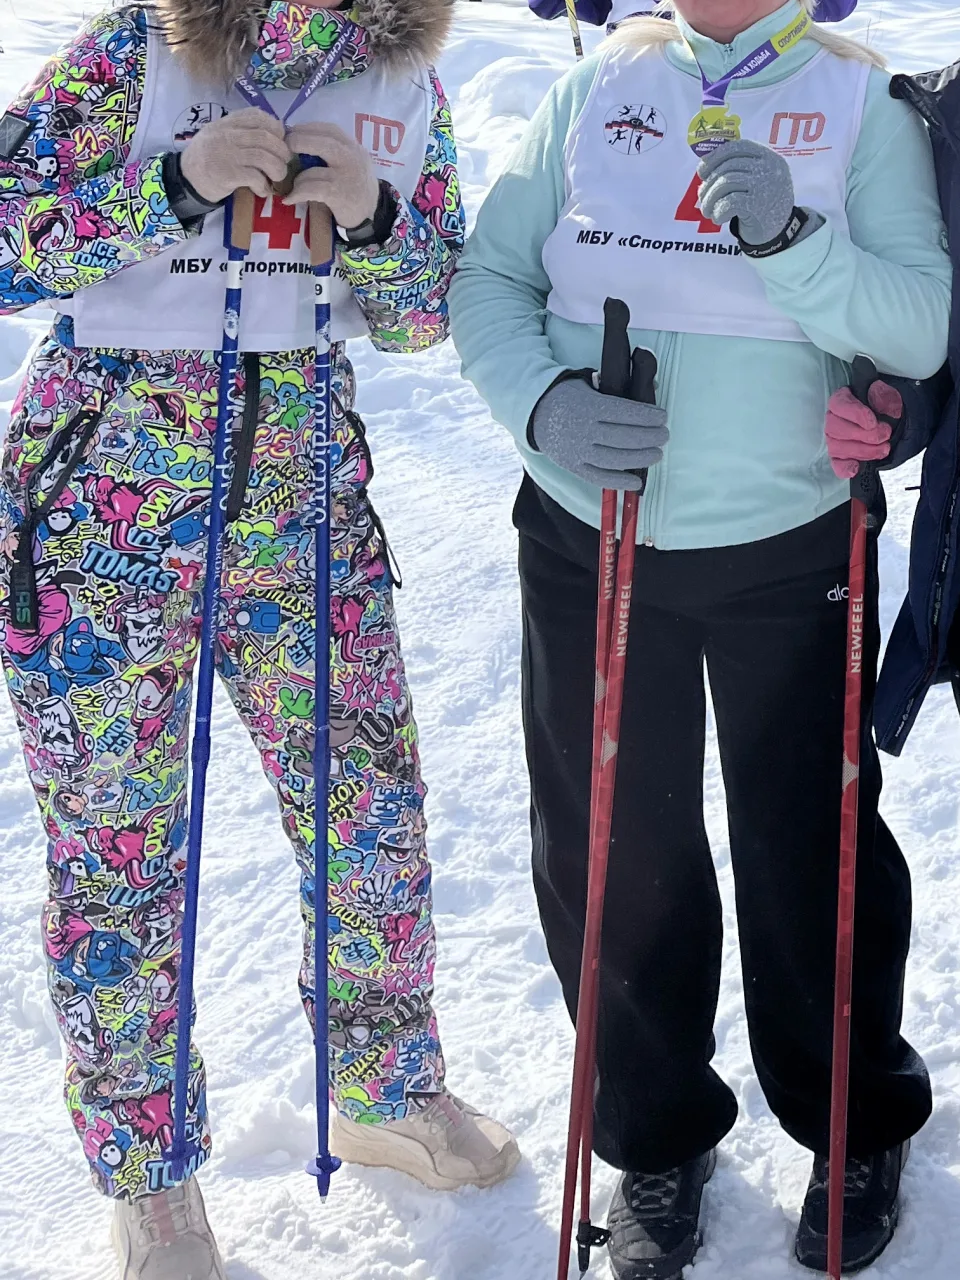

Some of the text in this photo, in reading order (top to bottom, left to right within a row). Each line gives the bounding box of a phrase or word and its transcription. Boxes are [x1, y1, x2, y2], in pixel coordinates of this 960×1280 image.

[769, 112, 826, 145] ГТО
[91, 241, 118, 257] ICE
[576, 229, 614, 246] МБУ
[170, 258, 213, 274] МБУ
[312, 380, 331, 525] nordicpro
[82, 544, 178, 592] TOMAS
[616, 581, 632, 657] NEWFEEL
[850, 593, 864, 673] NEWFEEL
